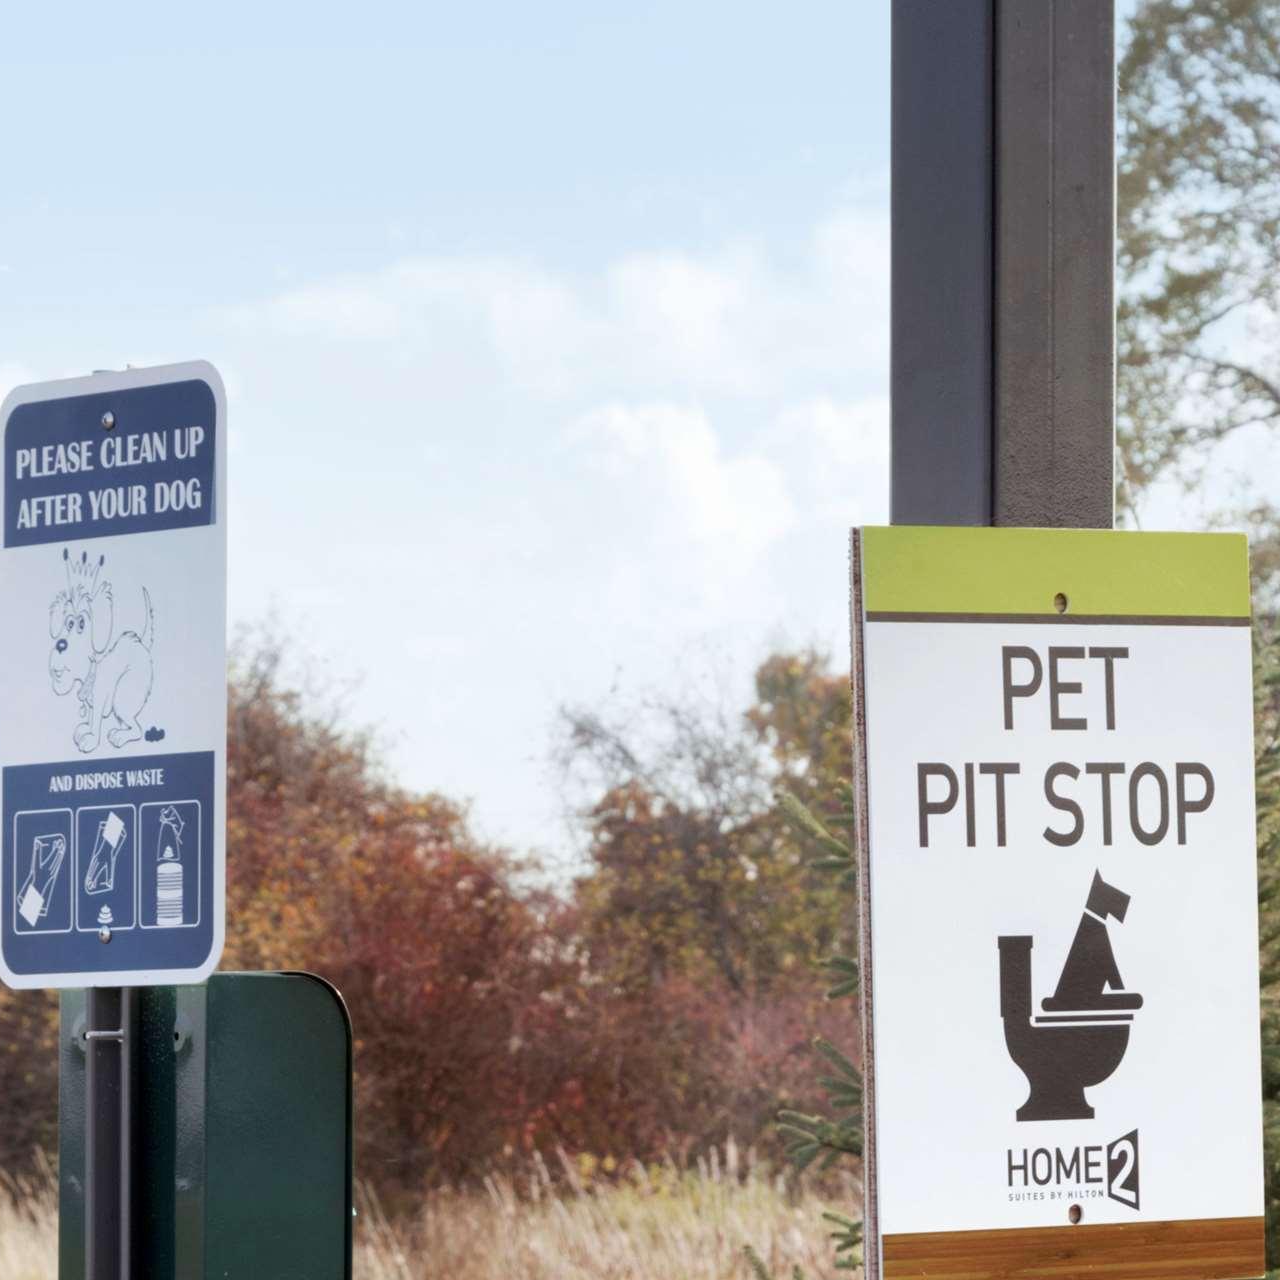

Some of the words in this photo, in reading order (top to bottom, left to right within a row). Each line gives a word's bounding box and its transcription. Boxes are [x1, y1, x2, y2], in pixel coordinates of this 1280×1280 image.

[16, 440, 94, 480] PLEASE
[100, 430, 167, 469] CLEAN
[174, 426, 205, 459] UP
[17, 492, 82, 529] AFTER
[89, 485, 147, 521] YOUR
[154, 478, 202, 513] DOG
[1002, 645, 1129, 731] PET
[49, 775, 72, 792] AND
[75, 771, 124, 791] DISPOSE
[126, 768, 164, 787] WASTE
[917, 762, 1020, 847] PIT
[1042, 761, 1215, 847] STOP
[1008, 1192, 1045, 1202] SUITES
[1050, 1191, 1063, 1200] BY
[1067, 1188, 1104, 1199] HILTON
